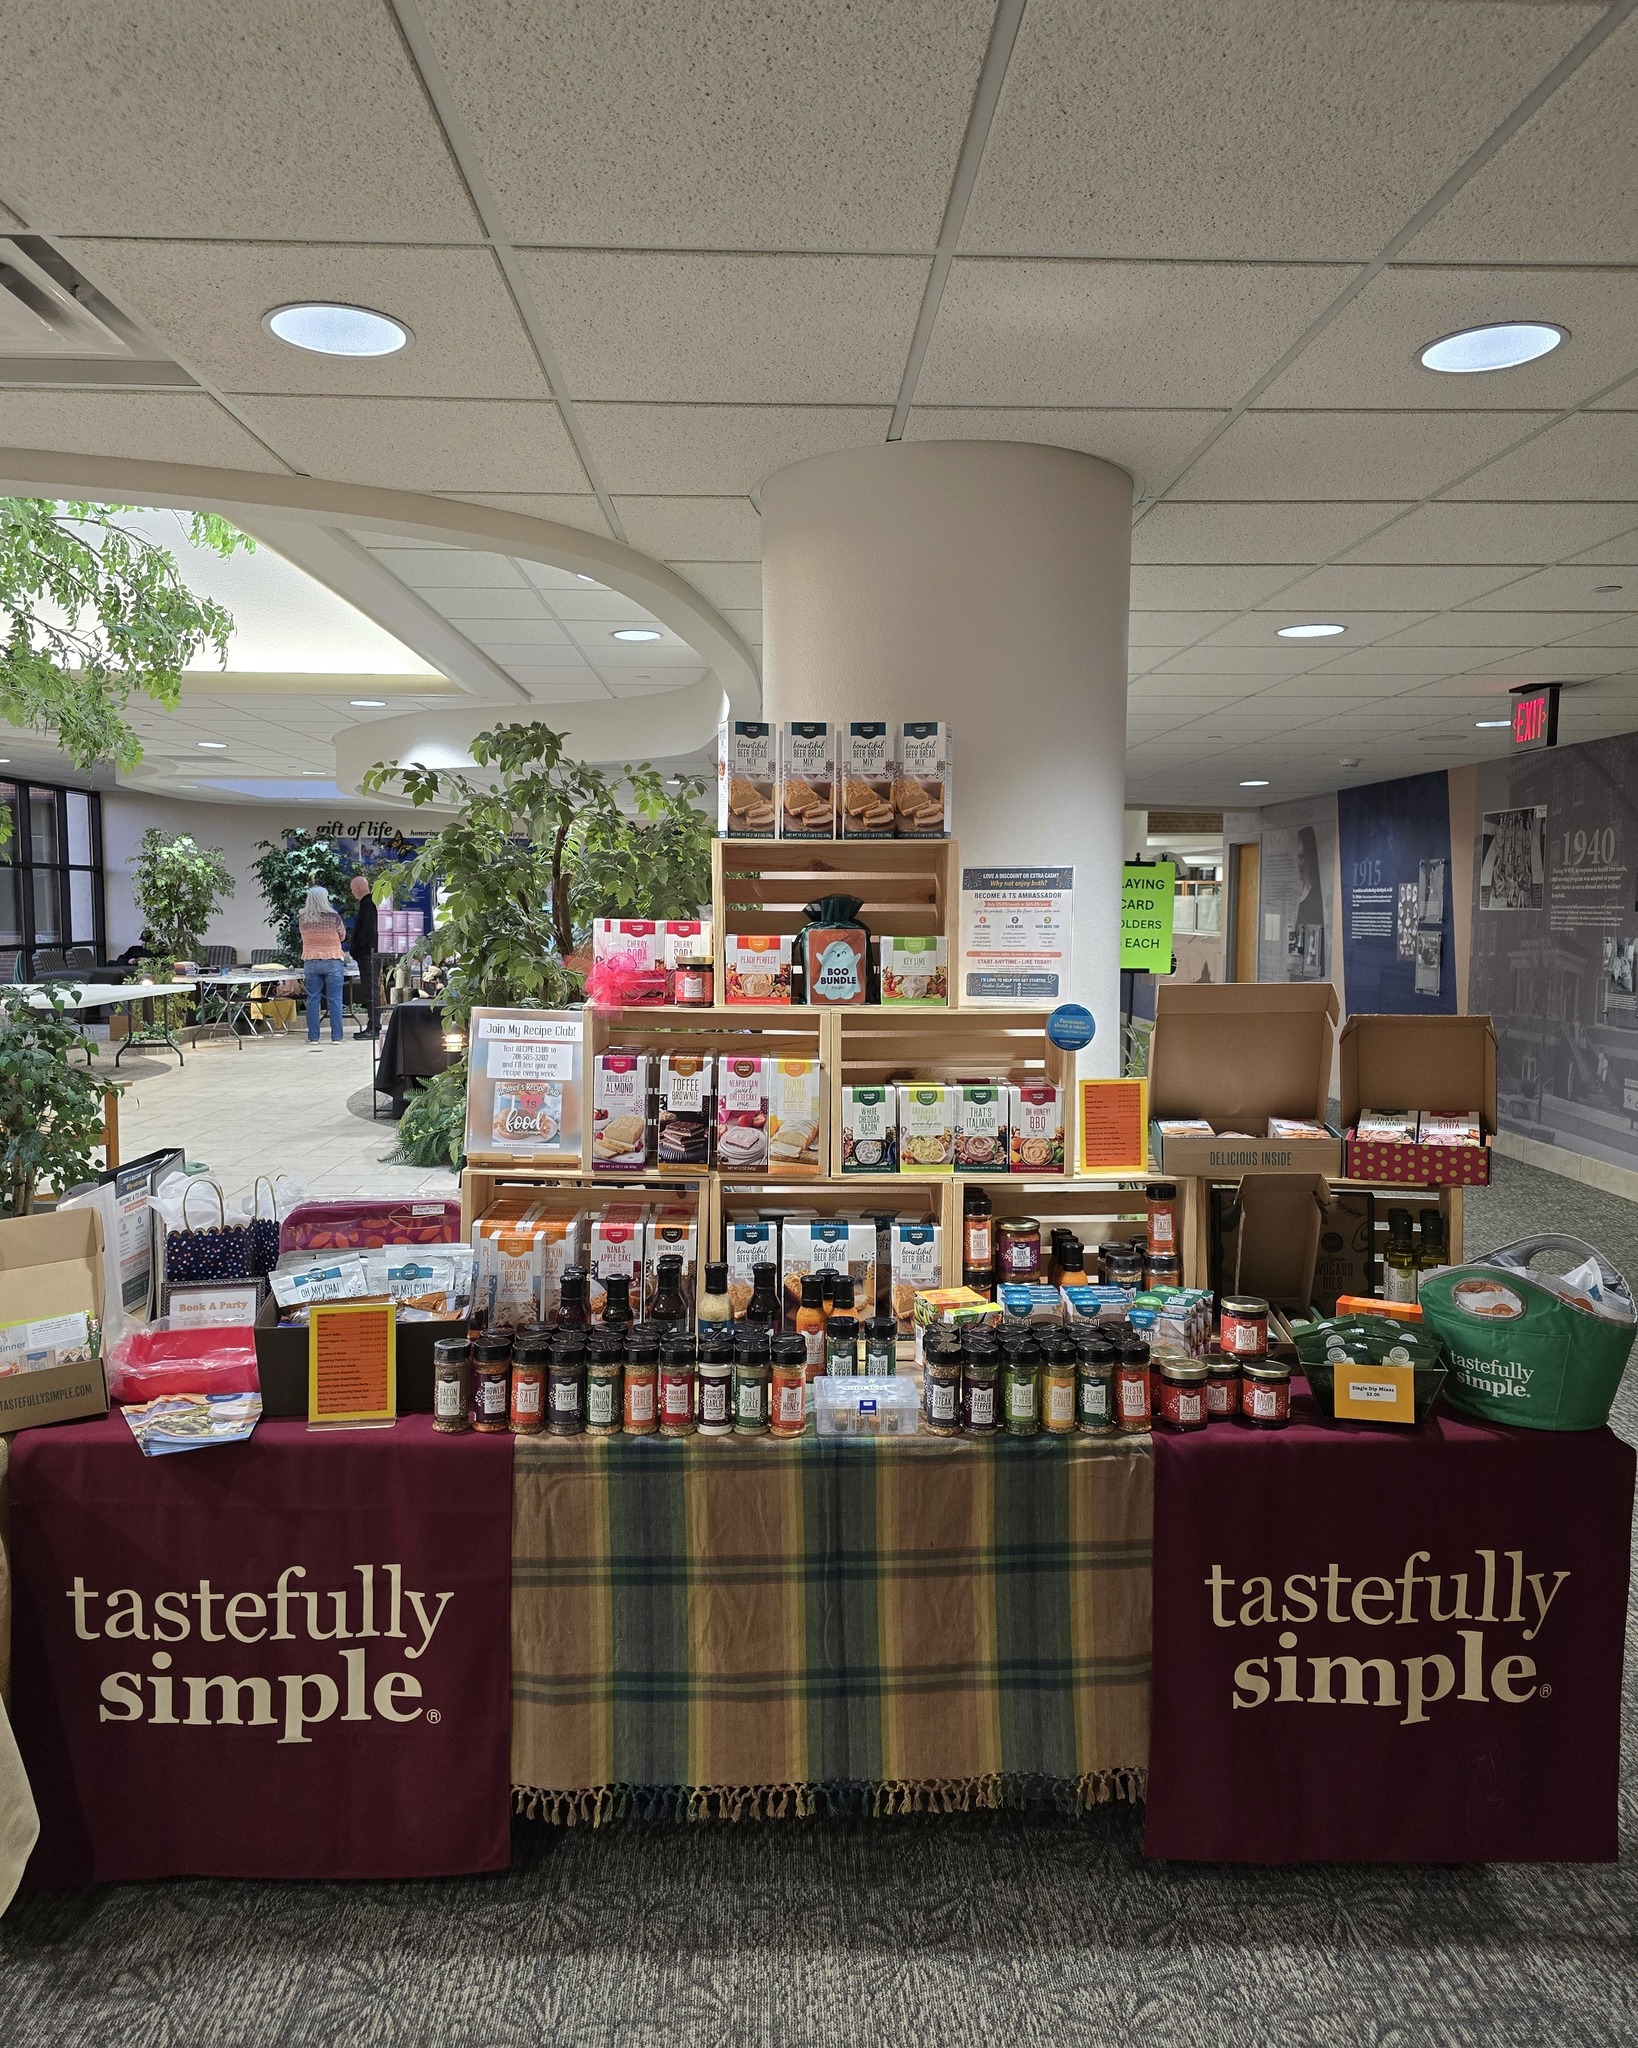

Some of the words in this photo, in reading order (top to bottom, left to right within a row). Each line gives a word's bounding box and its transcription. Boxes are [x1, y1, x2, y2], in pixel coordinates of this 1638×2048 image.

[1516, 698, 1545, 742] EXIT
[737, 750, 749, 758] BEER
[751, 750, 767, 758] BREAD
[793, 750, 806, 758] BEER
[808, 750, 824, 758] BREAD
[853, 750, 866, 758] BEER
[868, 750, 884, 758] BREAD
[906, 750, 918, 758] BEER
[920, 750, 935, 758] BREAD
[317, 821, 344, 837] gift
[347, 822, 366, 840] of
[368, 822, 393, 841] life
[1562, 828, 1615, 865] 1940
[1353, 860, 1381, 886] 1915
[627, 940, 647, 948] CHERRY
[674, 940, 693, 948] CHERRY
[1125, 938, 1160, 948] EACH
[627, 949, 647, 961] SODA
[740, 956, 755, 964] PEACH
[756, 956, 776, 964] PERFECT
[903, 957, 912, 966] KEY
[914, 957, 926, 966] LIME
[821, 977, 856, 985] BUNDLE
[487, 1023, 506, 1034] Join
[508, 1024, 520, 1037] My
[523, 1025, 552, 1038] Recipe
[555, 1026, 576, 1037] Club!
[502, 1069, 522, 1078] recipe
[522, 1070, 539, 1078] every
[606, 1083, 633, 1093] ALMOND
[672, 1079, 698, 1091] TOFFEE
[784, 1079, 805, 1088] SUNNY
[526, 1084, 545, 1093] Recipe
[672, 1091, 698, 1100] BROWNIE
[783, 1090, 806, 1100] LEMON
[526, 1100, 536, 1109] ts
[970, 1108, 992, 1117] THAT'S
[1026, 1108, 1032, 1116] OH
[1034, 1108, 1050, 1116] HONEY!
[505, 1108, 547, 1133] food.
[966, 1118, 996, 1128] ITALIANO!
[1030, 1117, 1046, 1129] BBQ
[861, 1123, 877, 1131] BACON
[1210, 1151, 1258, 1166] DELICIOUS
[1261, 1152, 1292, 1166] INSIDE
[1156, 1222, 1170, 1230] TACO
[737, 1246, 767, 1254] bountiful
[813, 1244, 845, 1253] bountiful
[902, 1247, 932, 1255] bountiful
[601, 1254, 619, 1262] APPLE
[619, 1254, 631, 1262] CAKE
[814, 1253, 827, 1261] BEER
[829, 1253, 845, 1261] BREAD
[501, 1260, 530, 1270] PUMPKIN
[1314, 1263, 1353, 1276] AVOCADO
[505, 1271, 526, 1281] BREAD
[1323, 1276, 1342, 1290] OILS
[301, 1288, 310, 1297] OH
[391, 1285, 399, 1295] OH
[179, 1303, 206, 1312] Book
[209, 1302, 217, 1310] A
[219, 1301, 248, 1311] Party
[1142, 1331, 1154, 1341] POT
[1450, 1350, 1534, 1383] tastefully
[1457, 1370, 1531, 1398] simple.
[440, 1388, 457, 1396] BACON
[1014, 1389, 1031, 1397] SPINACH
[1125, 1386, 1142, 1394] FIESTA
[1352, 1385, 1367, 1393] Single
[0, 1383, 93, 1412] TASTEFULLYSIMPLE.COM
[520, 1392, 538, 1404] SALT
[558, 1392, 576, 1401] PEPPER
[592, 1390, 610, 1400] ONION
[634, 1391, 651, 1399] GARLIC
[745, 1391, 756, 1400] DILL
[787, 1392, 797, 1401] HOT
[975, 1394, 992, 1402] GARLIC
[1125, 1394, 1142, 1404] PARTY
[440, 1397, 457, 1406] BACON
[592, 1400, 610, 1409] ONION
[706, 1400, 724, 1408] GARLIC
[742, 1400, 758, 1408] PICKLE
[935, 1397, 951, 1406] STEAK
[1019, 1397, 1031, 1405] HERB
[783, 1402, 799, 1411] HONEY
[974, 1402, 991, 1410] PEPPER
[1204, 1549, 1571, 1640] tastefully
[66, 1563, 455, 1659] tastefully
